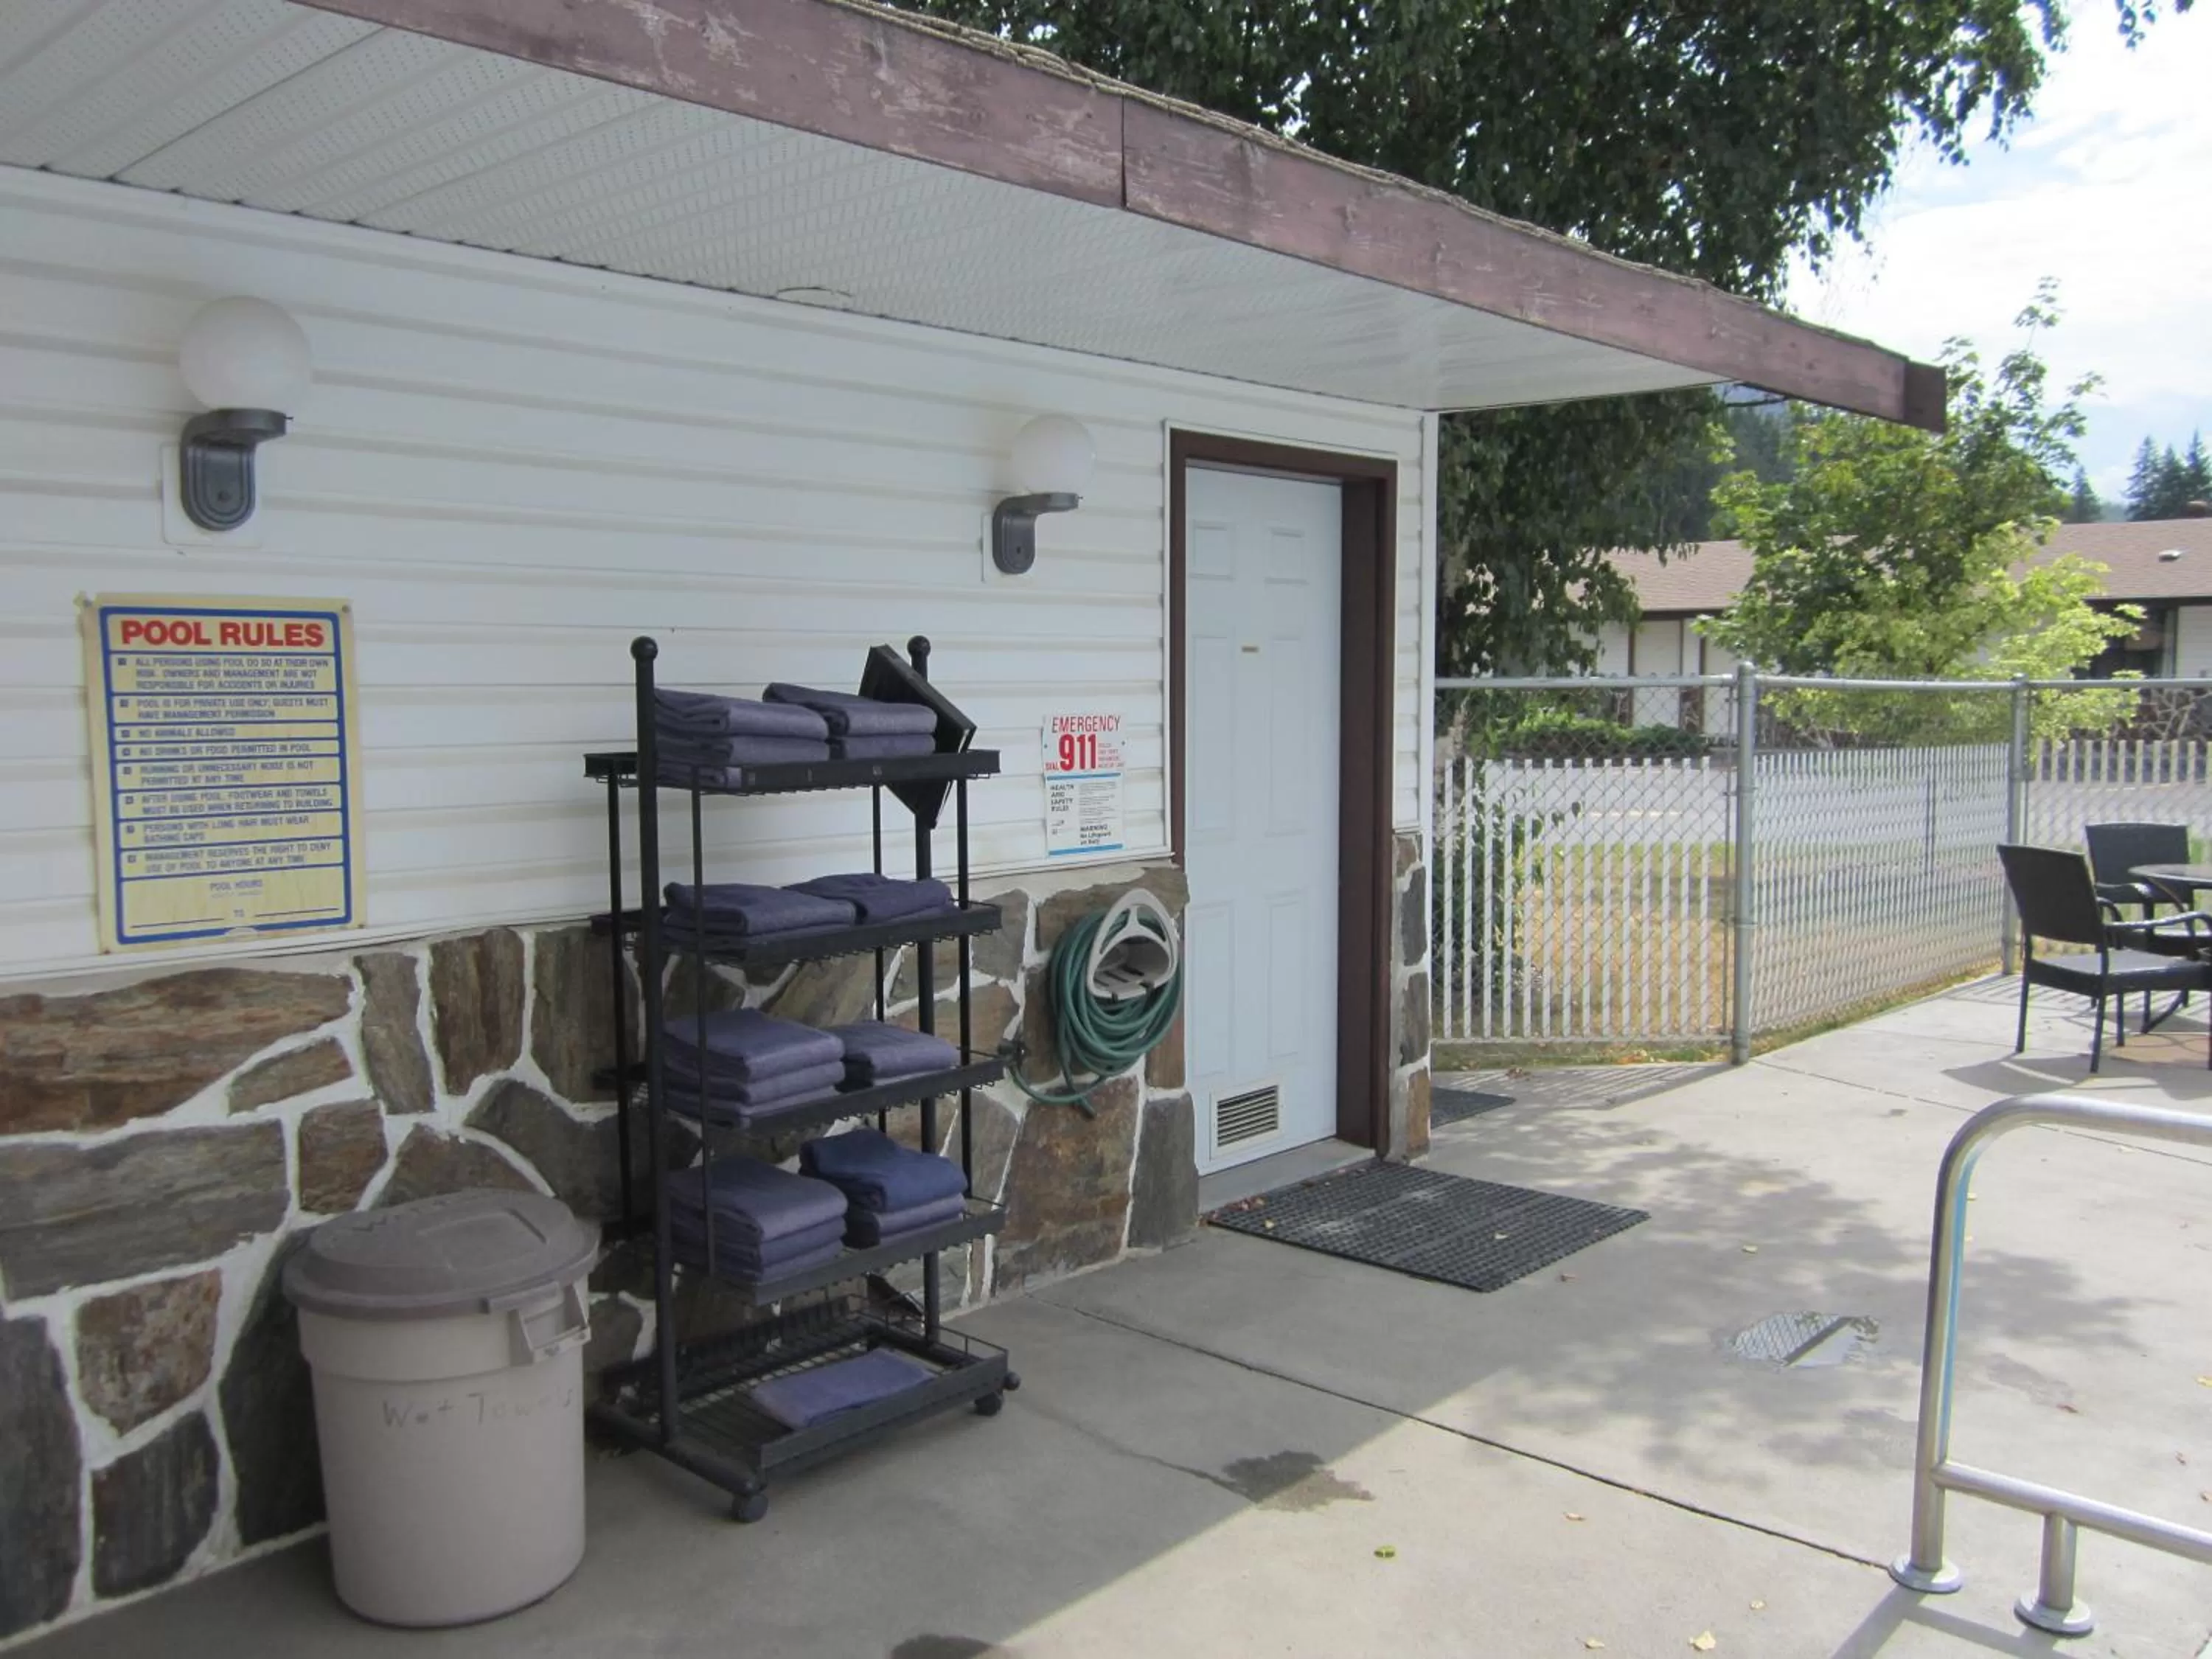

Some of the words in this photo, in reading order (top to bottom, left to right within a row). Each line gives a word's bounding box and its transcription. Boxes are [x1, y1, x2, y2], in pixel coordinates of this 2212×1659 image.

[121, 620, 212, 645] POOL
[218, 622, 324, 647] RULES
[136, 657, 150, 667] ALL
[223, 658, 243, 667] POOL
[247, 658, 258, 667] DO
[261, 658, 272, 667] SO
[274, 658, 282, 667] AT
[309, 658, 328, 668] OWN
[203, 669, 220, 678] AND
[223, 669, 279, 678] MANAGEMENT
[301, 669, 317, 678] NOT
[197, 680, 215, 689] FOR
[218, 680, 262, 689] ACCIDENTS
[265, 680, 276, 689] OR
[137, 699, 159, 709] POOL
[174, 698, 190, 708] FOR
[229, 698, 246, 707] USE
[306, 698, 328, 707] MUST
[163, 709, 221, 719] MANAGEMENT
[1052, 715, 1121, 733] EMERGENCY
[206, 745, 229, 754] FOOD
[231, 744, 277, 754] PERMITTED
[291, 743, 311, 752] POOL
[1059, 734, 1096, 772] 911
[297, 760, 314, 770] NOT
[229, 790, 273, 799] FOOTWEAR
[276, 789, 293, 798] AND
[295, 787, 327, 797] TOWELS
[283, 800, 293, 809] TO
[285, 815, 309, 825] WEAR
[270, 844, 294, 854] RIGHT
[297, 843, 307, 852] TO
[310, 842, 331, 852] DENY
[180, 861, 201, 871] POOL
[268, 856, 283, 865] ANY
[209, 883, 232, 891] POOL
